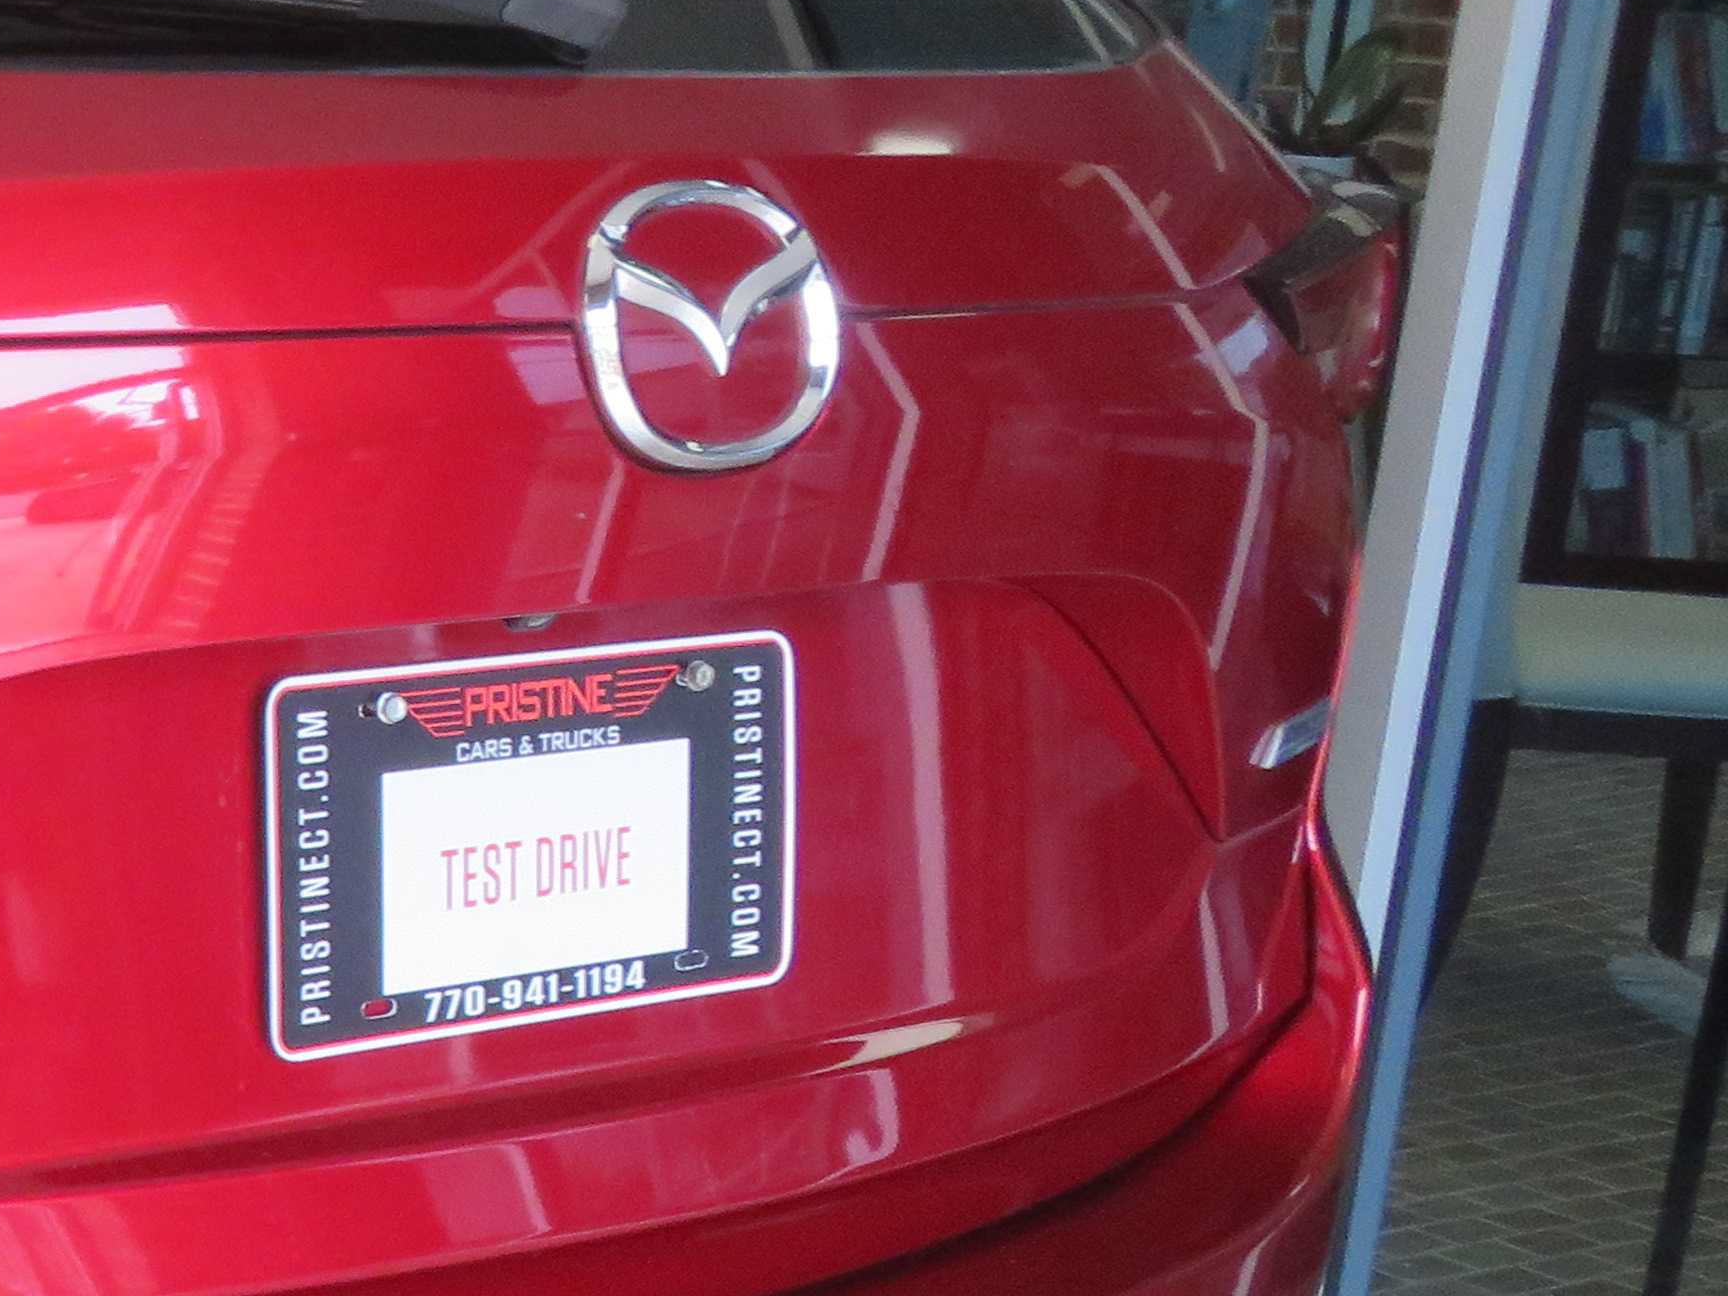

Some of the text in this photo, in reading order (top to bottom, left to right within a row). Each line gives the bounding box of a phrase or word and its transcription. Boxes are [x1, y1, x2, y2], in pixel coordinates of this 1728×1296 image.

[463, 673, 614, 727] PRISTINE
[455, 725, 621, 762] CARS & TRUCKS
[730, 665, 763, 958] PRISTINECT.COM
[296, 710, 331, 1025] PRISTINECT.COM
[440, 825, 631, 911] TEST DRIVE
[424, 960, 647, 1024] 770-941-1194
